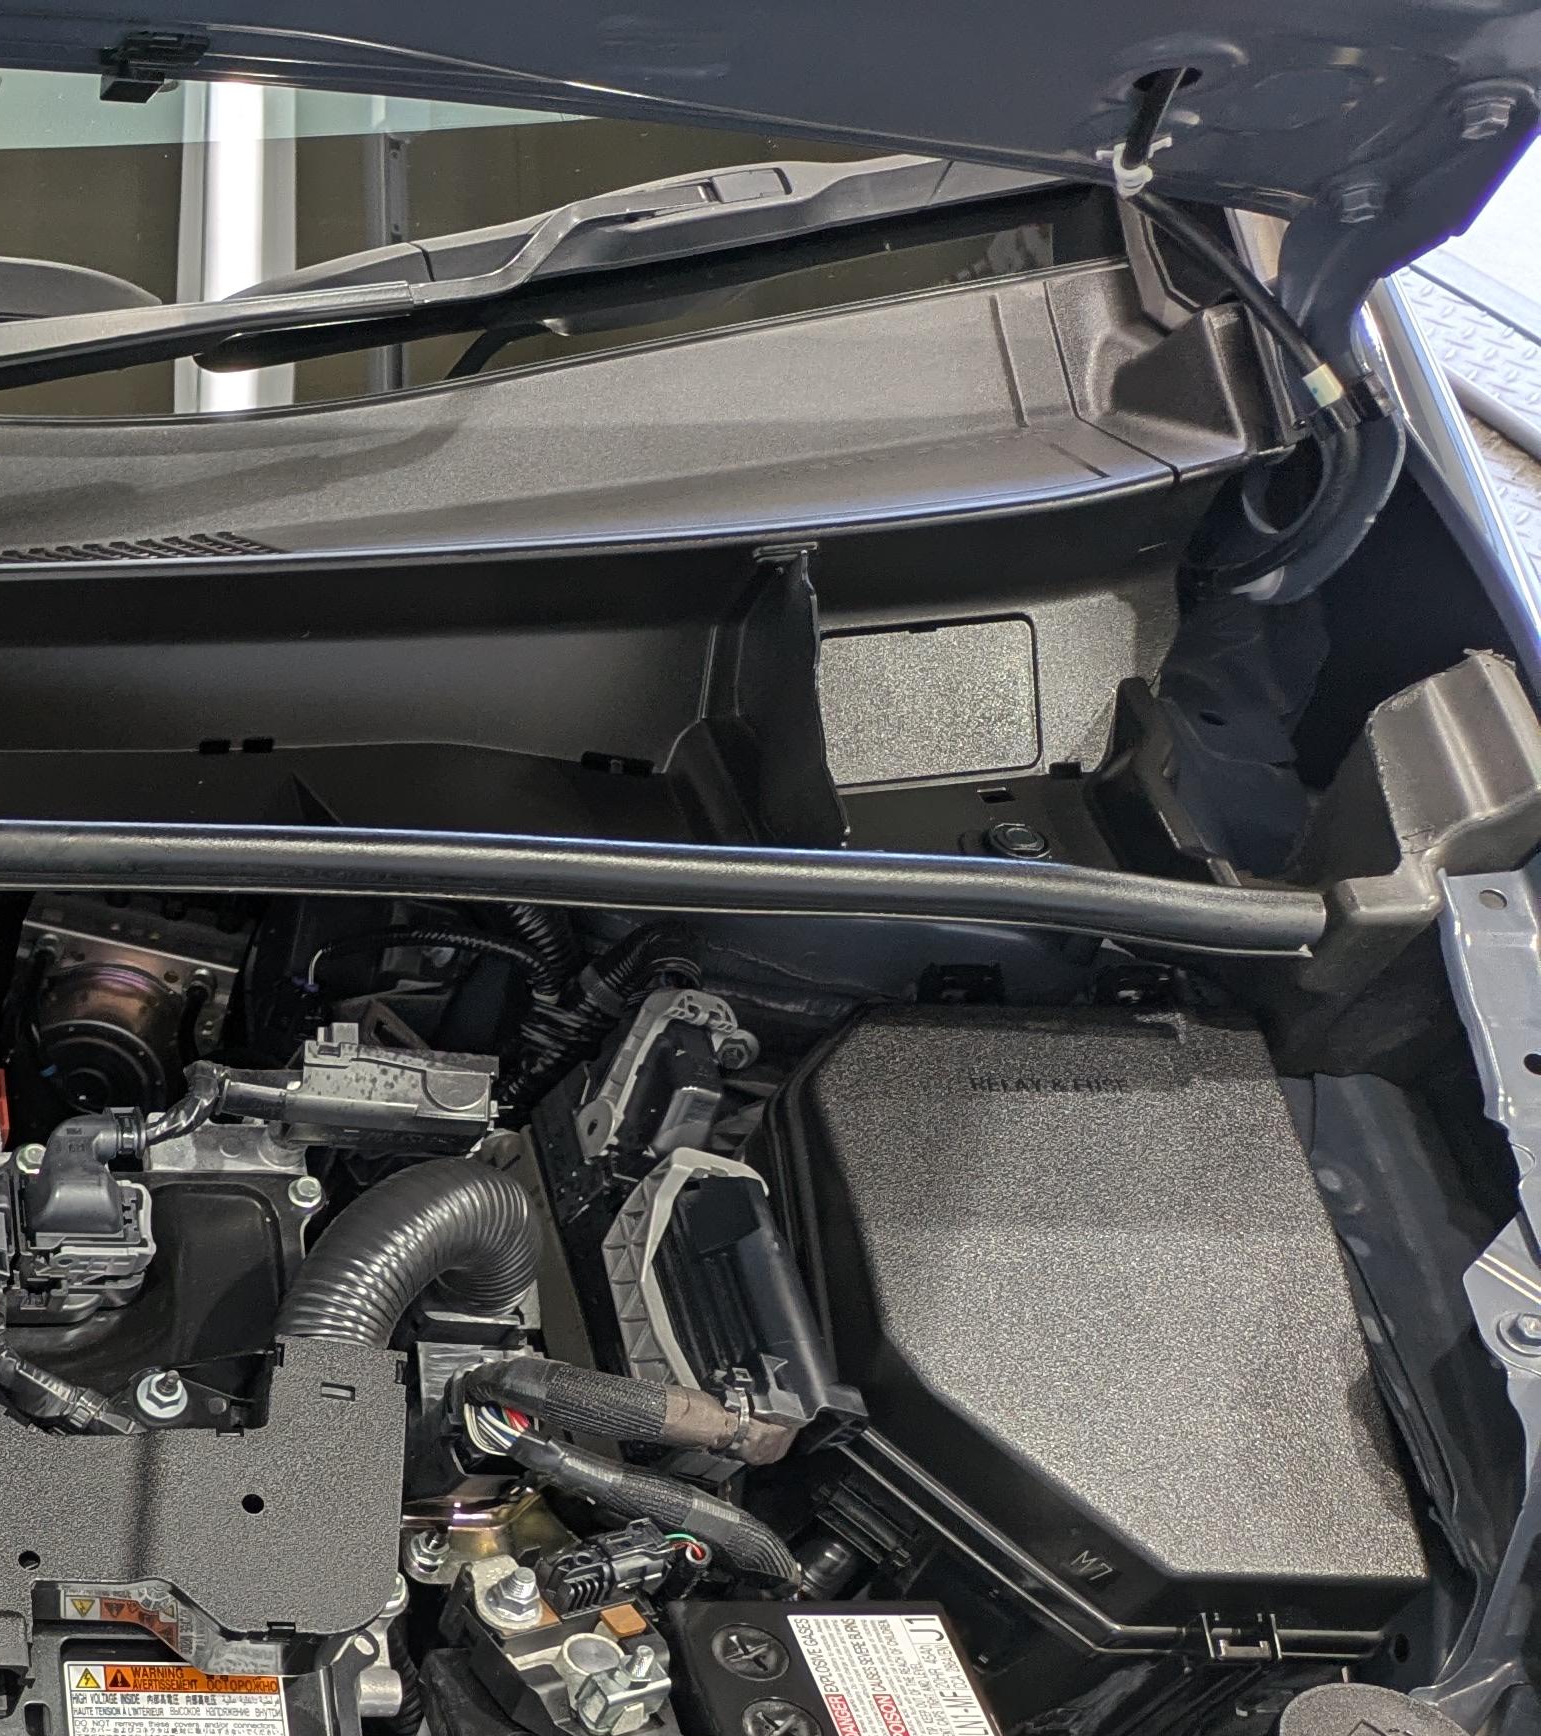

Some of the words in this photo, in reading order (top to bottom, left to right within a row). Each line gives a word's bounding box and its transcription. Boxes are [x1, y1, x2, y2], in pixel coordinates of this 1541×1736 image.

[793, 1618, 818, 1645] GASES
[904, 1617, 945, 1641] J1
[131, 1667, 184, 1679] WARNING
[807, 1648, 839, 1691] EXPLOSIVE
[132, 1679, 198, 1690] AVERTISSEMENT
[862, 1667, 886, 1691] CAUSES
[206, 1680, 278, 1692] ОСТОРОЖНО
[90, 1693, 118, 1704] VOLTAGE
[120, 1694, 140, 1704] INSIDE
[75, 1719, 87, 1727] DO
[92, 1719, 110, 1727] NOT
